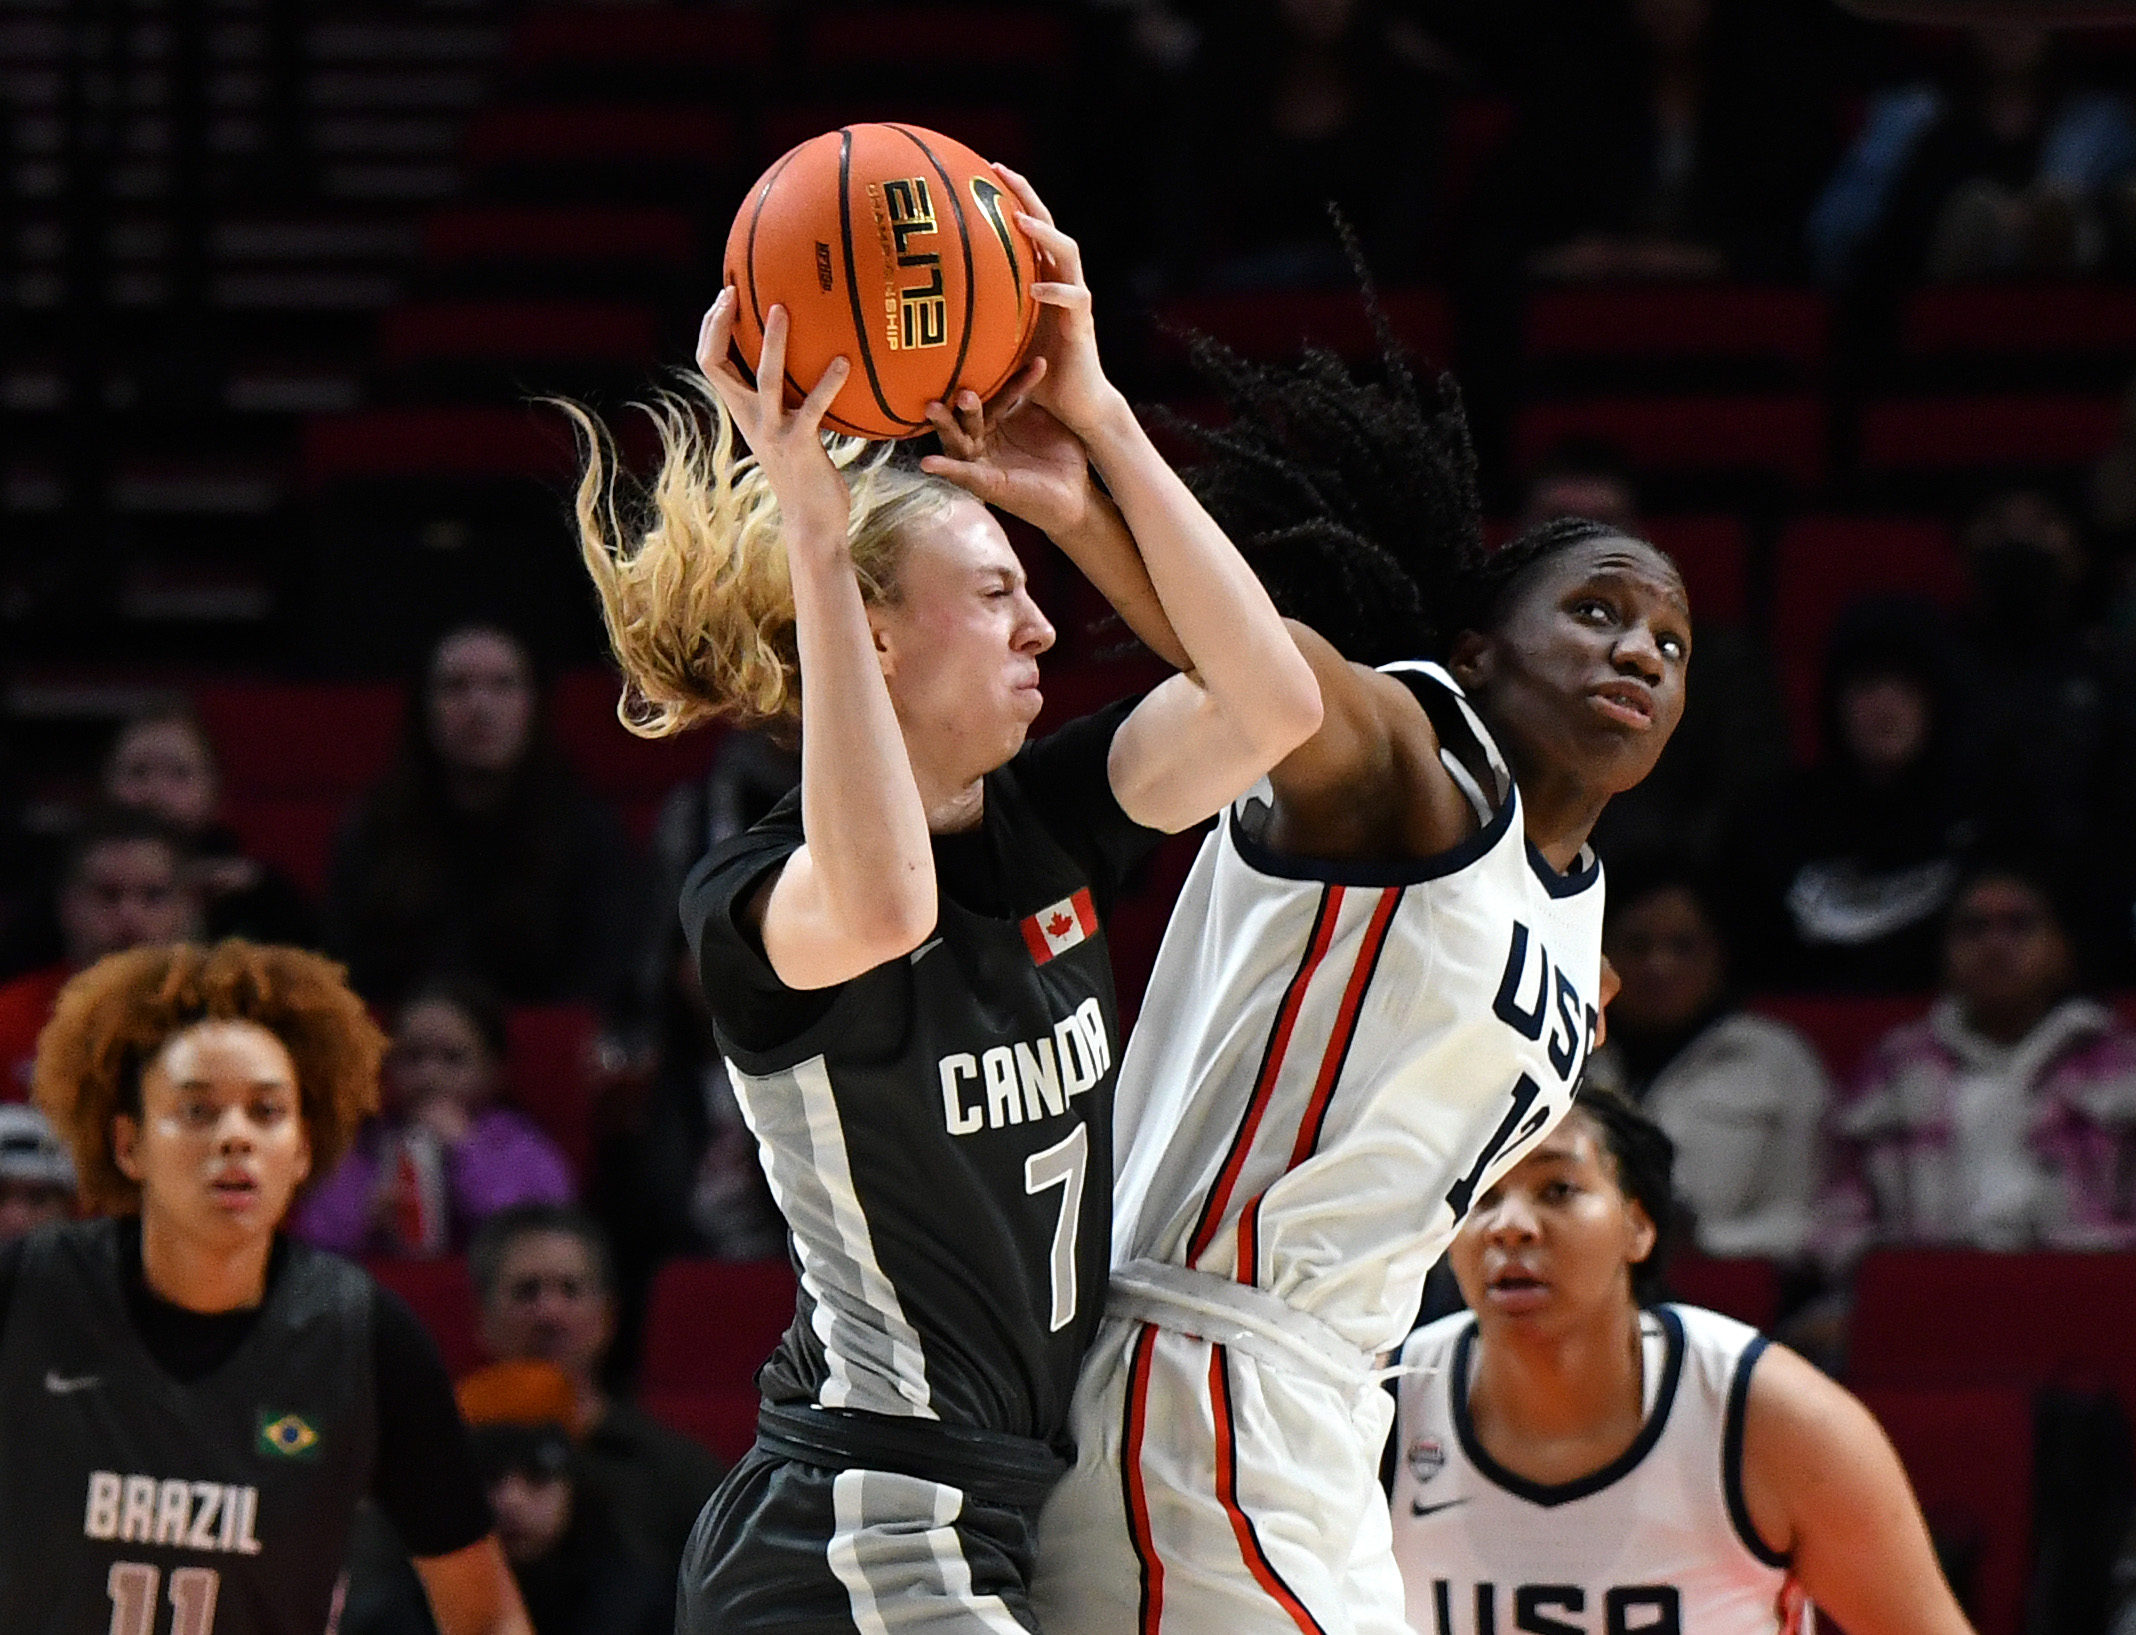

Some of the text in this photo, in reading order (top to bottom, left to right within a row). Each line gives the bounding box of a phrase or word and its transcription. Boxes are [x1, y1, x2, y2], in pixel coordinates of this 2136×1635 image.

[882, 176, 948, 350] ELITE
[1025, 1121, 1088, 1333] 7
[84, 1469, 262, 1555] BRAZIL
[106, 1560, 220, 1635] 11
